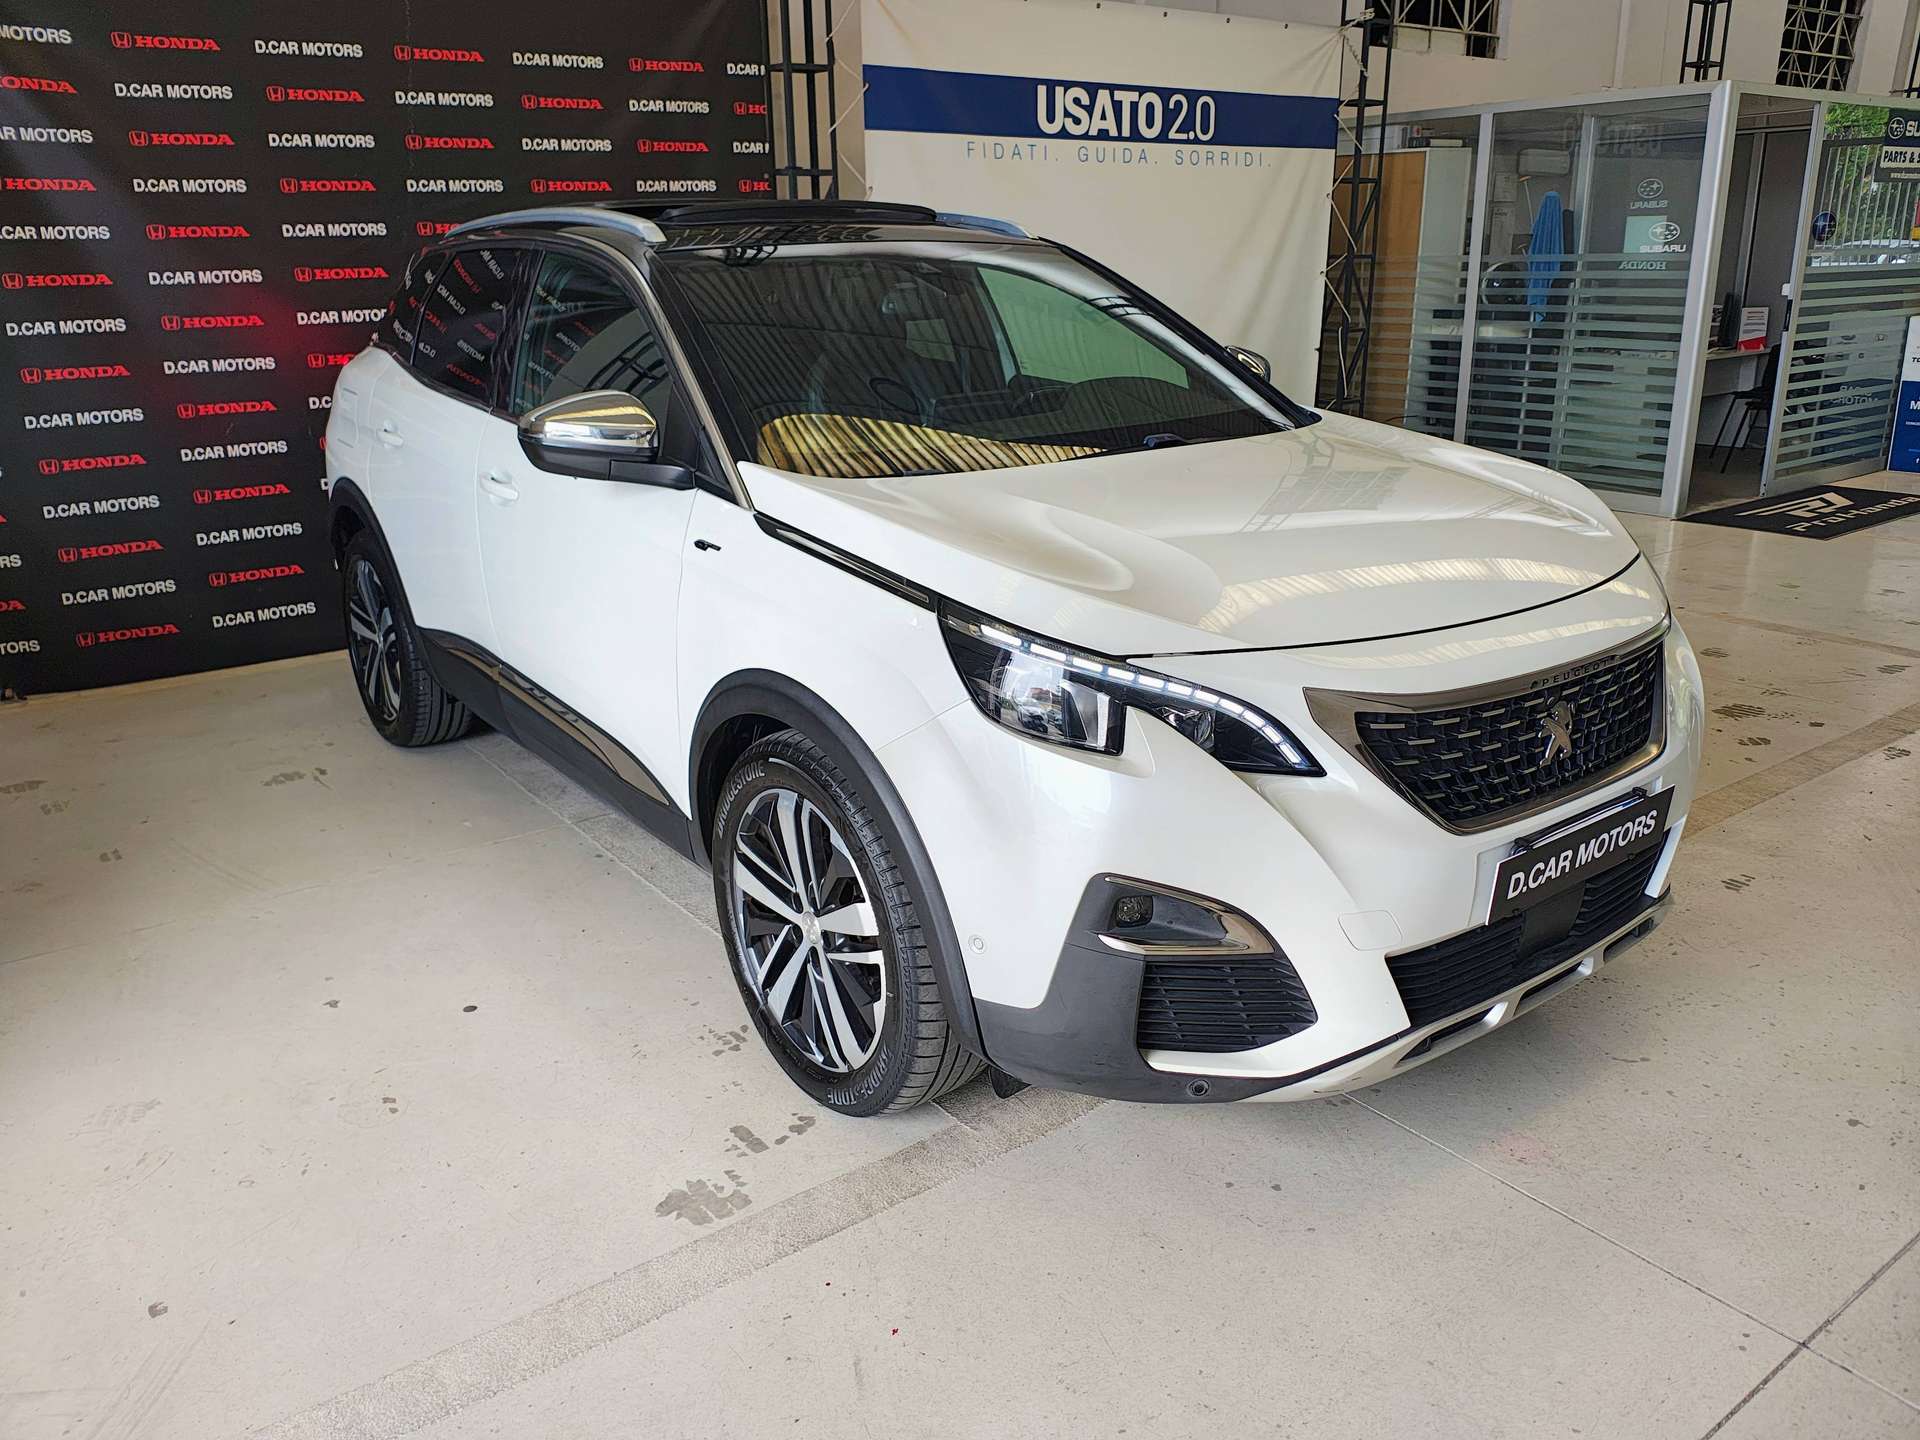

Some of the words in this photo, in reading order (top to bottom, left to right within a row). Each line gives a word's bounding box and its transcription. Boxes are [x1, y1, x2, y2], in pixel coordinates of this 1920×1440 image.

[134, 35, 219, 51] HONDA
[254, 39, 300, 55] D.CAR
[302, 42, 363, 58] MOTORS
[413, 47, 484, 63] HONDA
[512, 52, 551, 66] D.CAR
[553, 54, 604, 69] MOTORS
[644, 60, 703, 74] HONDA
[727, 63, 759, 76] D.CAR
[0, 75, 78, 94] ONDA
[114, 81, 163, 98] D.CAR
[167, 84, 233, 101] MOTORS
[287, 87, 364, 102] HONDA
[394, 91, 436, 105] D.CAR
[438, 92, 494, 107] MOTORS
[538, 96, 602, 109] HONDA
[628, 99, 664, 112] D.CAR
[666, 100, 710, 114] MOTORS
[1037, 84, 1163, 139] USATO
[1168, 93, 1216, 141] 2.0
[19, 127, 94, 144] MOTORS
[151, 132, 234, 145] HONDA
[268, 133, 313, 147] D.CAR
[315, 134, 376, 148] MOTORS
[423, 137, 494, 149] HONDA
[521, 137, 559, 151] D.CAR
[561, 139, 613, 152] MOTORS
[651, 141, 709, 153] HONDA
[733, 141, 764, 154] D.CAR
[967, 142, 1059, 162] FIDATI.
[1077, 146, 1158, 165] GUIDA.
[1175, 149, 1272, 168] SORRIDI.
[1883, 150, 1907, 163] PARTS
[5, 178, 97, 192] HONDA
[132, 178, 180, 193] D.CAR
[182, 179, 247, 193] MOTORS
[299, 179, 375, 193] HONDA
[406, 179, 447, 193] D.CAR
[449, 179, 504, 193] MOTORS
[547, 180, 610, 192] HONDA
[636, 180, 668, 192] D.CAR
[670, 180, 717, 193] MOTORS
[40, 225, 111, 240] MOTORS
[167, 225, 250, 239] HONDA
[281, 223, 326, 239] D.CAR
[328, 222, 386, 237] MOTORS
[1640, 244, 1687, 253] SUBARU
[26, 273, 113, 288] HONDA
[148, 271, 196, 285] D.CAR
[199, 269, 262, 284] MOTORS
[313, 267, 388, 281] HONDA
[183, 315, 267, 329] HONDA
[296, 310, 340, 326] D.CAR
[5, 321, 55, 338] D.CAR
[59, 318, 127, 334] MOTORS
[44, 363, 129, 381] HONDA
[163, 359, 210, 376] D.CAR
[212, 356, 276, 372] MOTORS
[197, 400, 276, 416] HONDA
[23, 413, 74, 429] D.CAR
[77, 406, 143, 426] MOTORS
[180, 445, 225, 463] D.CAR
[227, 440, 288, 458] MOTORS
[62, 452, 145, 471] HONDA
[213, 482, 289, 501] HONDA
[42, 502, 90, 520] D.CAR
[94, 493, 160, 514] MOTORS
[196, 529, 240, 547] D.CAR
[243, 522, 302, 540] MOTORS
[79, 539, 161, 559] HONDA
[229, 563, 304, 583] HONDA
[61, 588, 108, 605] D.CAR
[112, 579, 177, 600] MOTORS
[212, 611, 254, 628] D.CAR
[258, 601, 317, 621] MOTORS
[98, 623, 177, 642] HONDA
[1542, 659, 1609, 687] PEUGEOT
[1507, 850, 1573, 900] D.CAR
[1576, 809, 1658, 868] MOTORS
